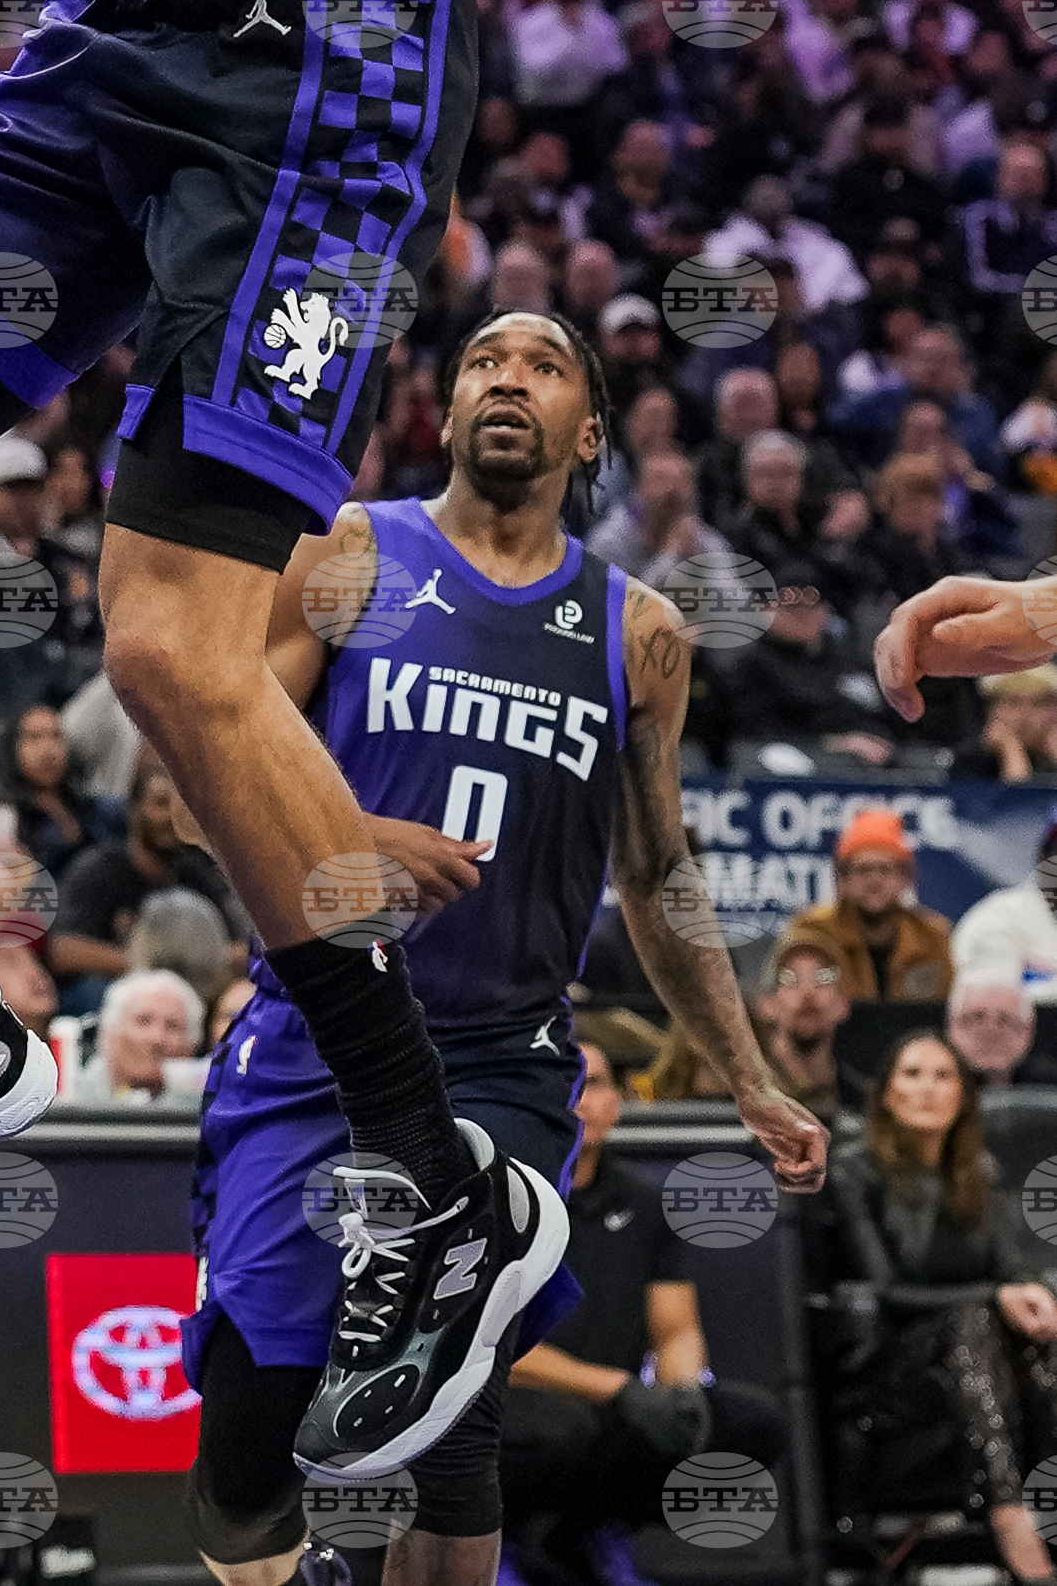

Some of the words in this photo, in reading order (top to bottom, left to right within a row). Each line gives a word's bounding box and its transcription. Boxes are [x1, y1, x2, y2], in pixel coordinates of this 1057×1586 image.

[428, 666, 562, 707] SACRAMENTO
[443, 765, 508, 862] 0
[762, 789, 954, 851] OFFCE
